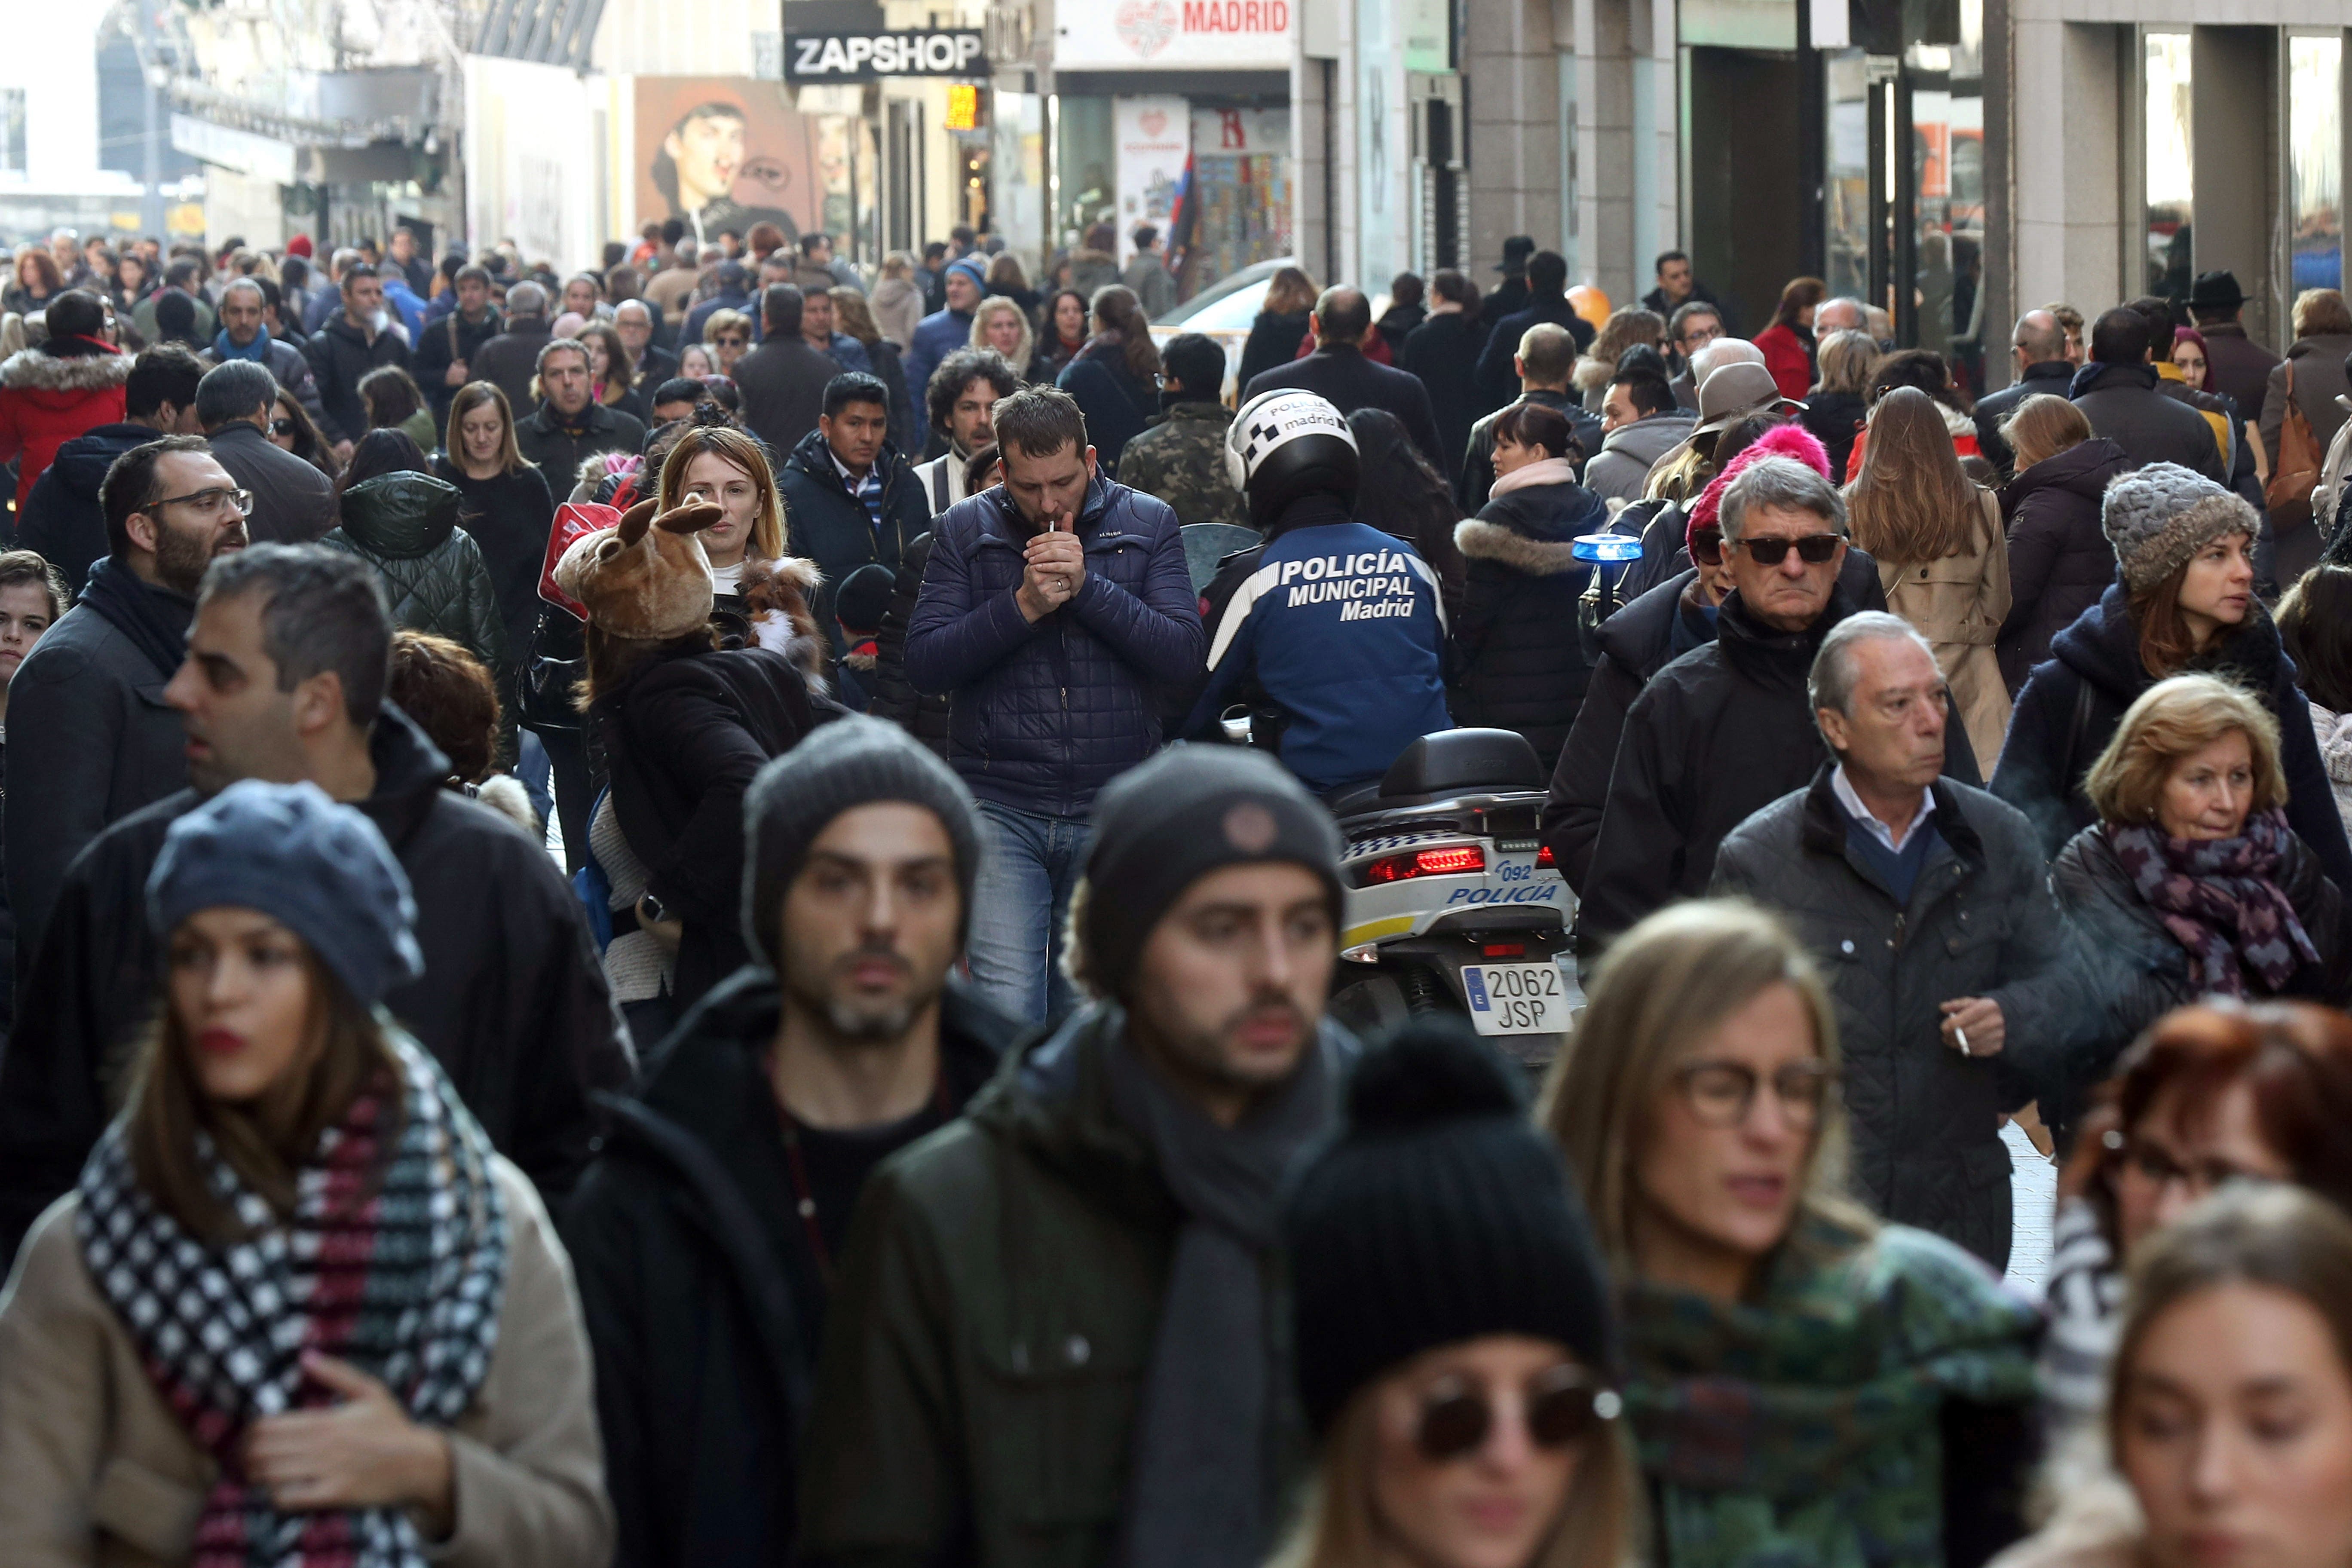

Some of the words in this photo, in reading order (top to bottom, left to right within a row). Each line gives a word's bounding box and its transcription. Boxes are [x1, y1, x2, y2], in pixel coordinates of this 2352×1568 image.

[1183, 0, 1287, 32] MADRID
[794, 34, 981, 74] ZAPSHOP
[1284, 413, 1335, 430] madrid
[1280, 548, 1407, 585] POLICÍA
[1287, 576, 1415, 607] MUNICIPAL
[1340, 598, 1415, 621] Madrid
[1503, 865, 1531, 882] 092
[1488, 969, 1559, 998] 2062
[1475, 995, 1484, 1004] E
[1498, 1000, 1545, 1028] JSP
